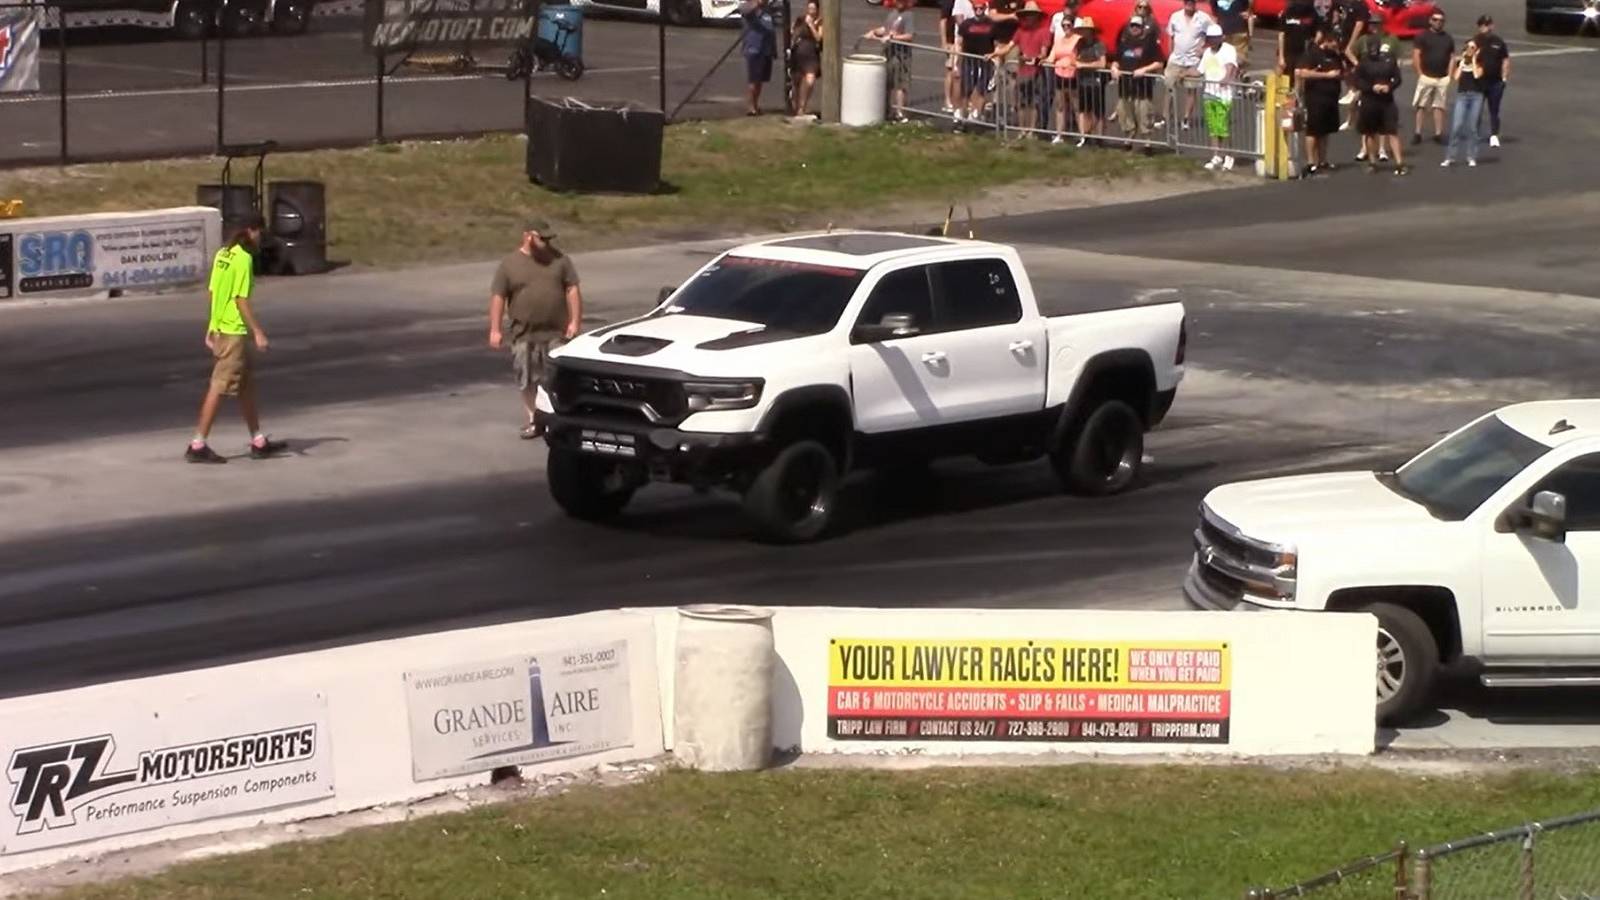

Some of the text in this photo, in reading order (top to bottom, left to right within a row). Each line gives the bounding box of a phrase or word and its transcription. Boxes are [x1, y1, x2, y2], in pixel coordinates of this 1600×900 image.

[20, 230, 95, 276] SRQ
[1496, 604, 1562, 612] SILVERADO
[839, 645, 1119, 683] YOUR LAWYER RACES HERE!
[1131, 650, 1220, 667] WE ONLY GET PAID
[1130, 666, 1156, 682] WHEN
[1157, 666, 1177, 682] YOU
[1178, 667, 1195, 682] GET
[433, 688, 600, 735] GRANDE AIRE
[837, 691, 1221, 713] CAR & MOTORCYCLE ACCIDENTS SLIP & FALLS MEDICAL MALPRACTICE
[472, 730, 521, 749] SERVICES
[837, 720, 863, 735] TRIPP
[864, 720, 884, 735] LAW
[885, 720, 907, 735] FIRM
[919, 720, 958, 736] CONTACT
[960, 721, 973, 736] US
[974, 721, 996, 736] 24/7
[1150, 723, 1220, 738] TRIPPFIRM.COM
[10, 729, 314, 828] TRZ MOTORSPORTS
[86, 770, 318, 823] Performance Suspension Components
